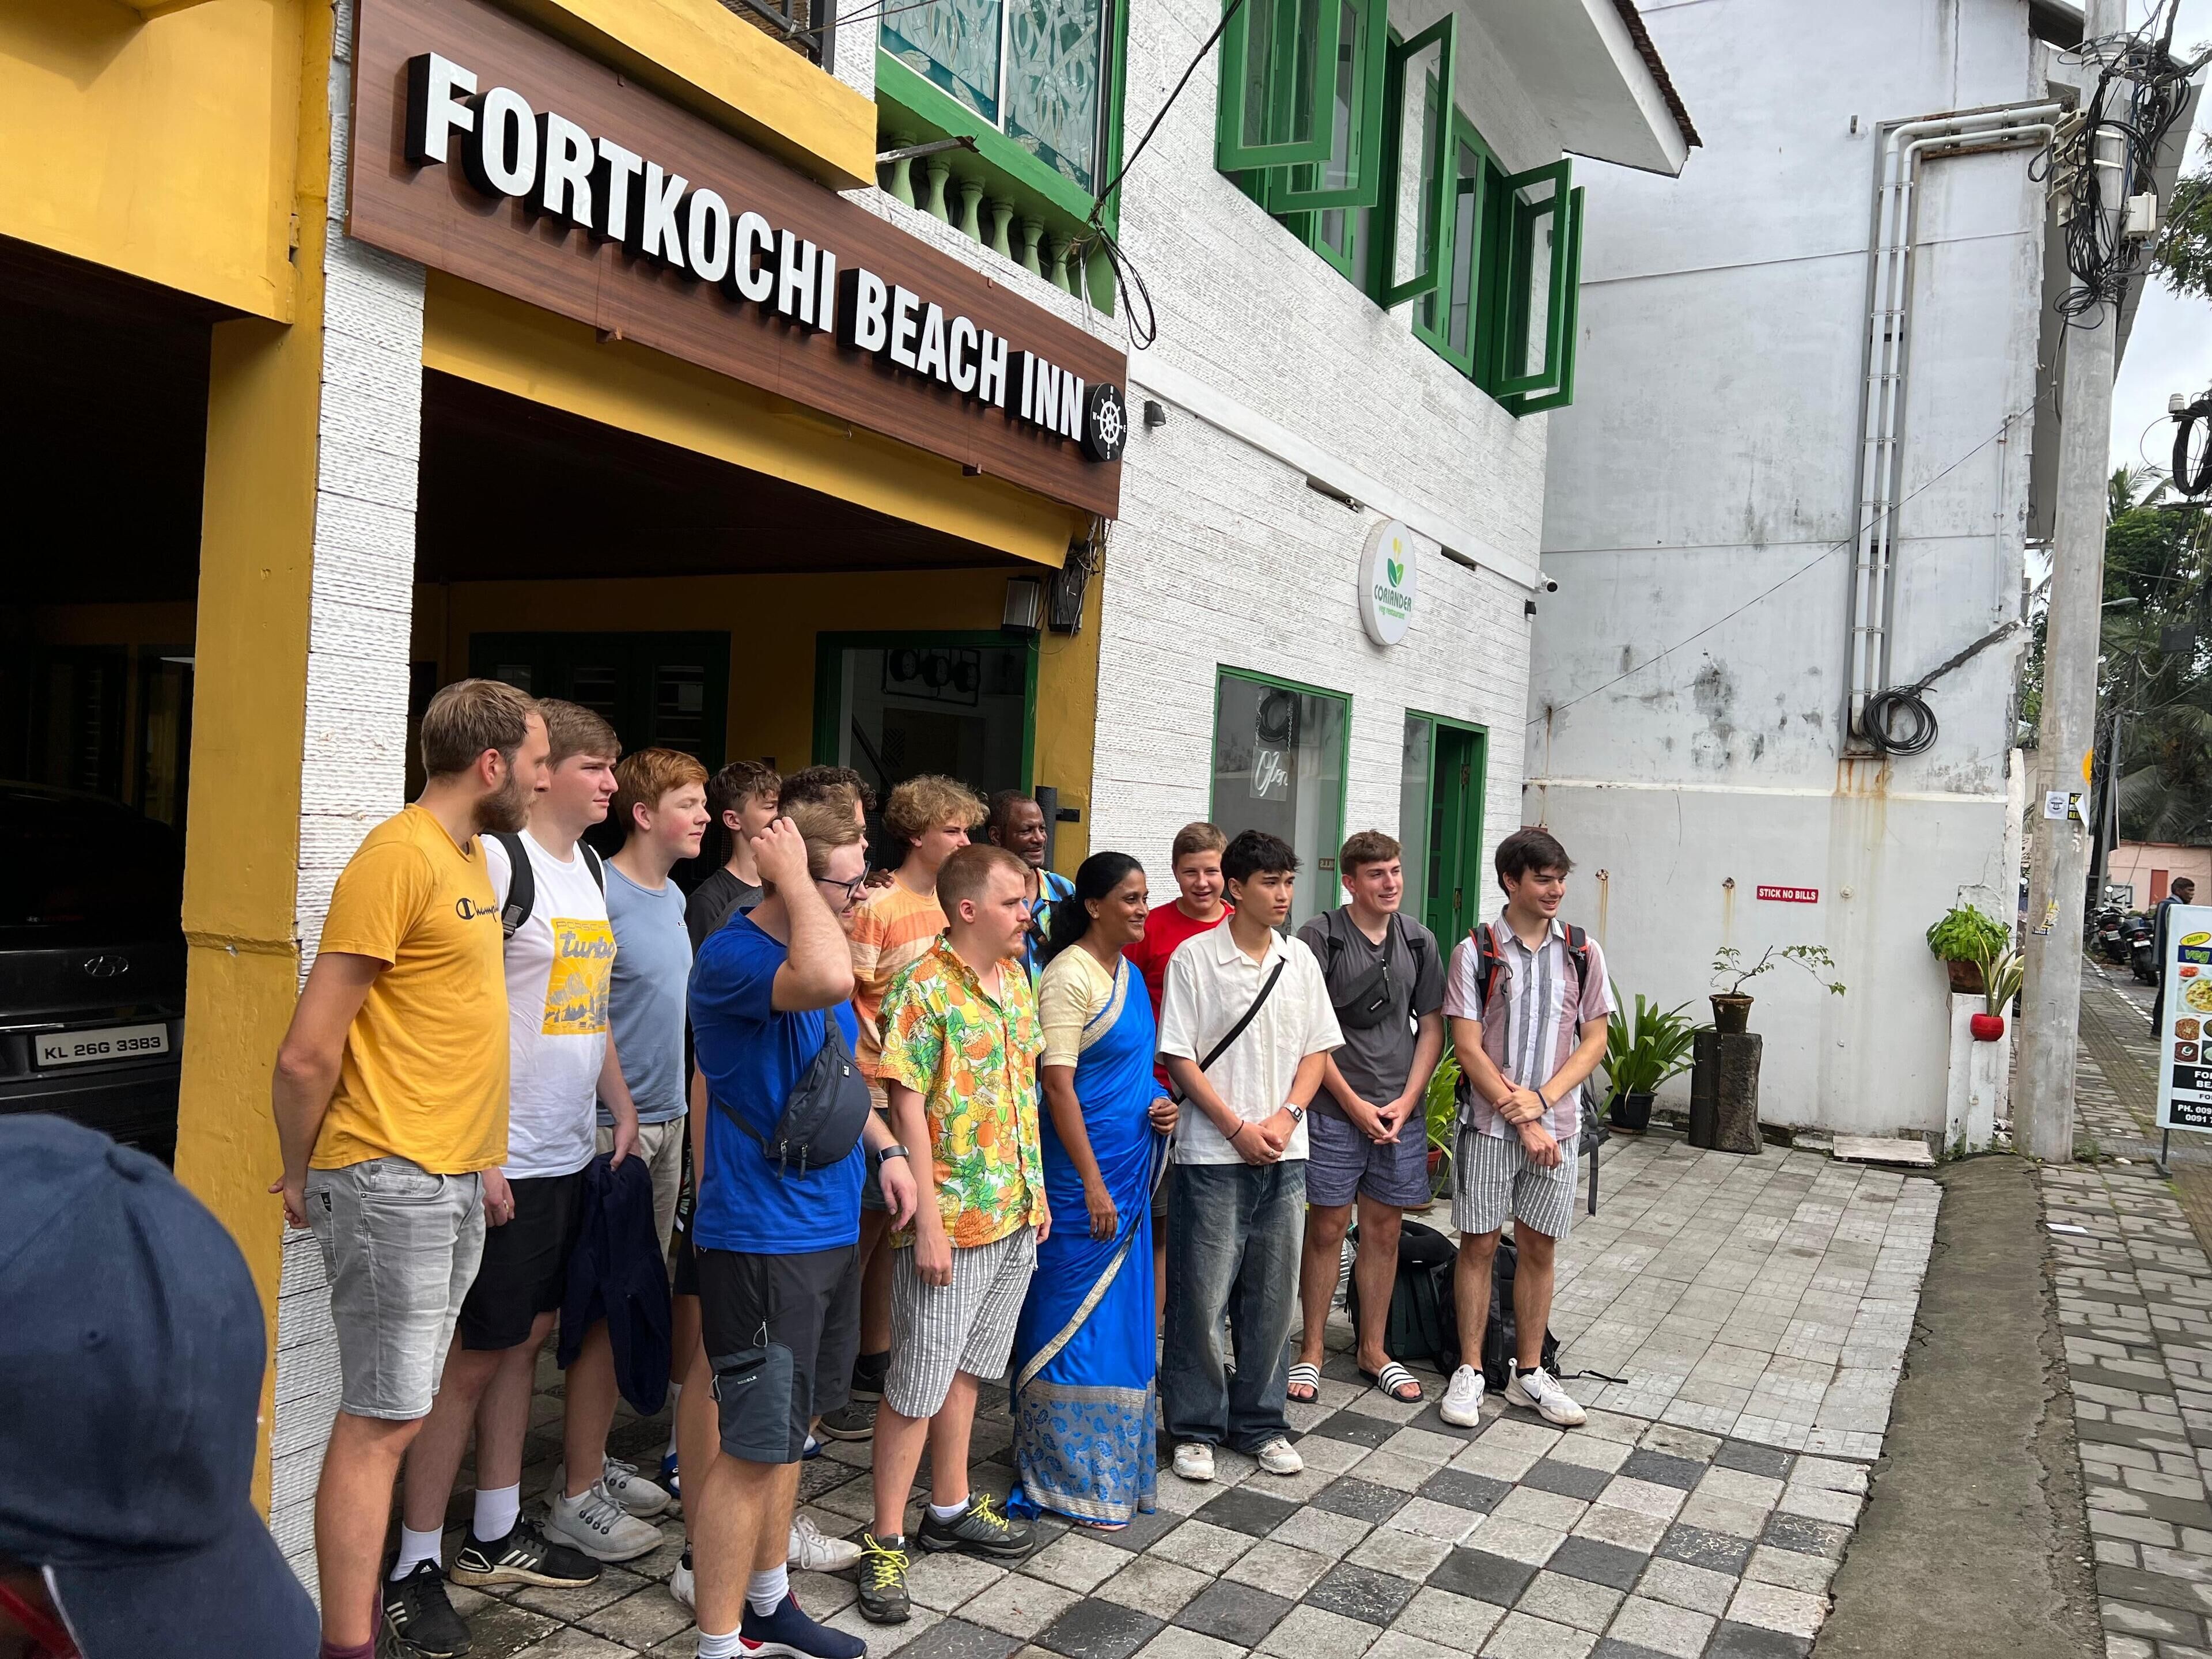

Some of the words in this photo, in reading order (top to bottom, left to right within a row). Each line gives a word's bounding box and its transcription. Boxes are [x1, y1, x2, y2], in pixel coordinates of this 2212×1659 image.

[424, 51, 836, 334] FORTKOCHI
[854, 267, 1009, 408] BEACH
[1021, 350, 1085, 442] INN
[1374, 584, 1411, 612] CORIANDER
[1759, 888, 1781, 898] STICK
[1783, 889, 1793, 899] NO
[1795, 891, 1816, 900] BILLS
[2187, 934, 2203, 944] pure
[2185, 949, 2210, 964] veg
[44, 1047, 68, 1059] KL
[74, 1041, 110, 1056] 26G
[116, 1037, 161, 1052] 3383
[2177, 1104, 2193, 1112] PH.
[2186, 1114, 2206, 1123] 0091
